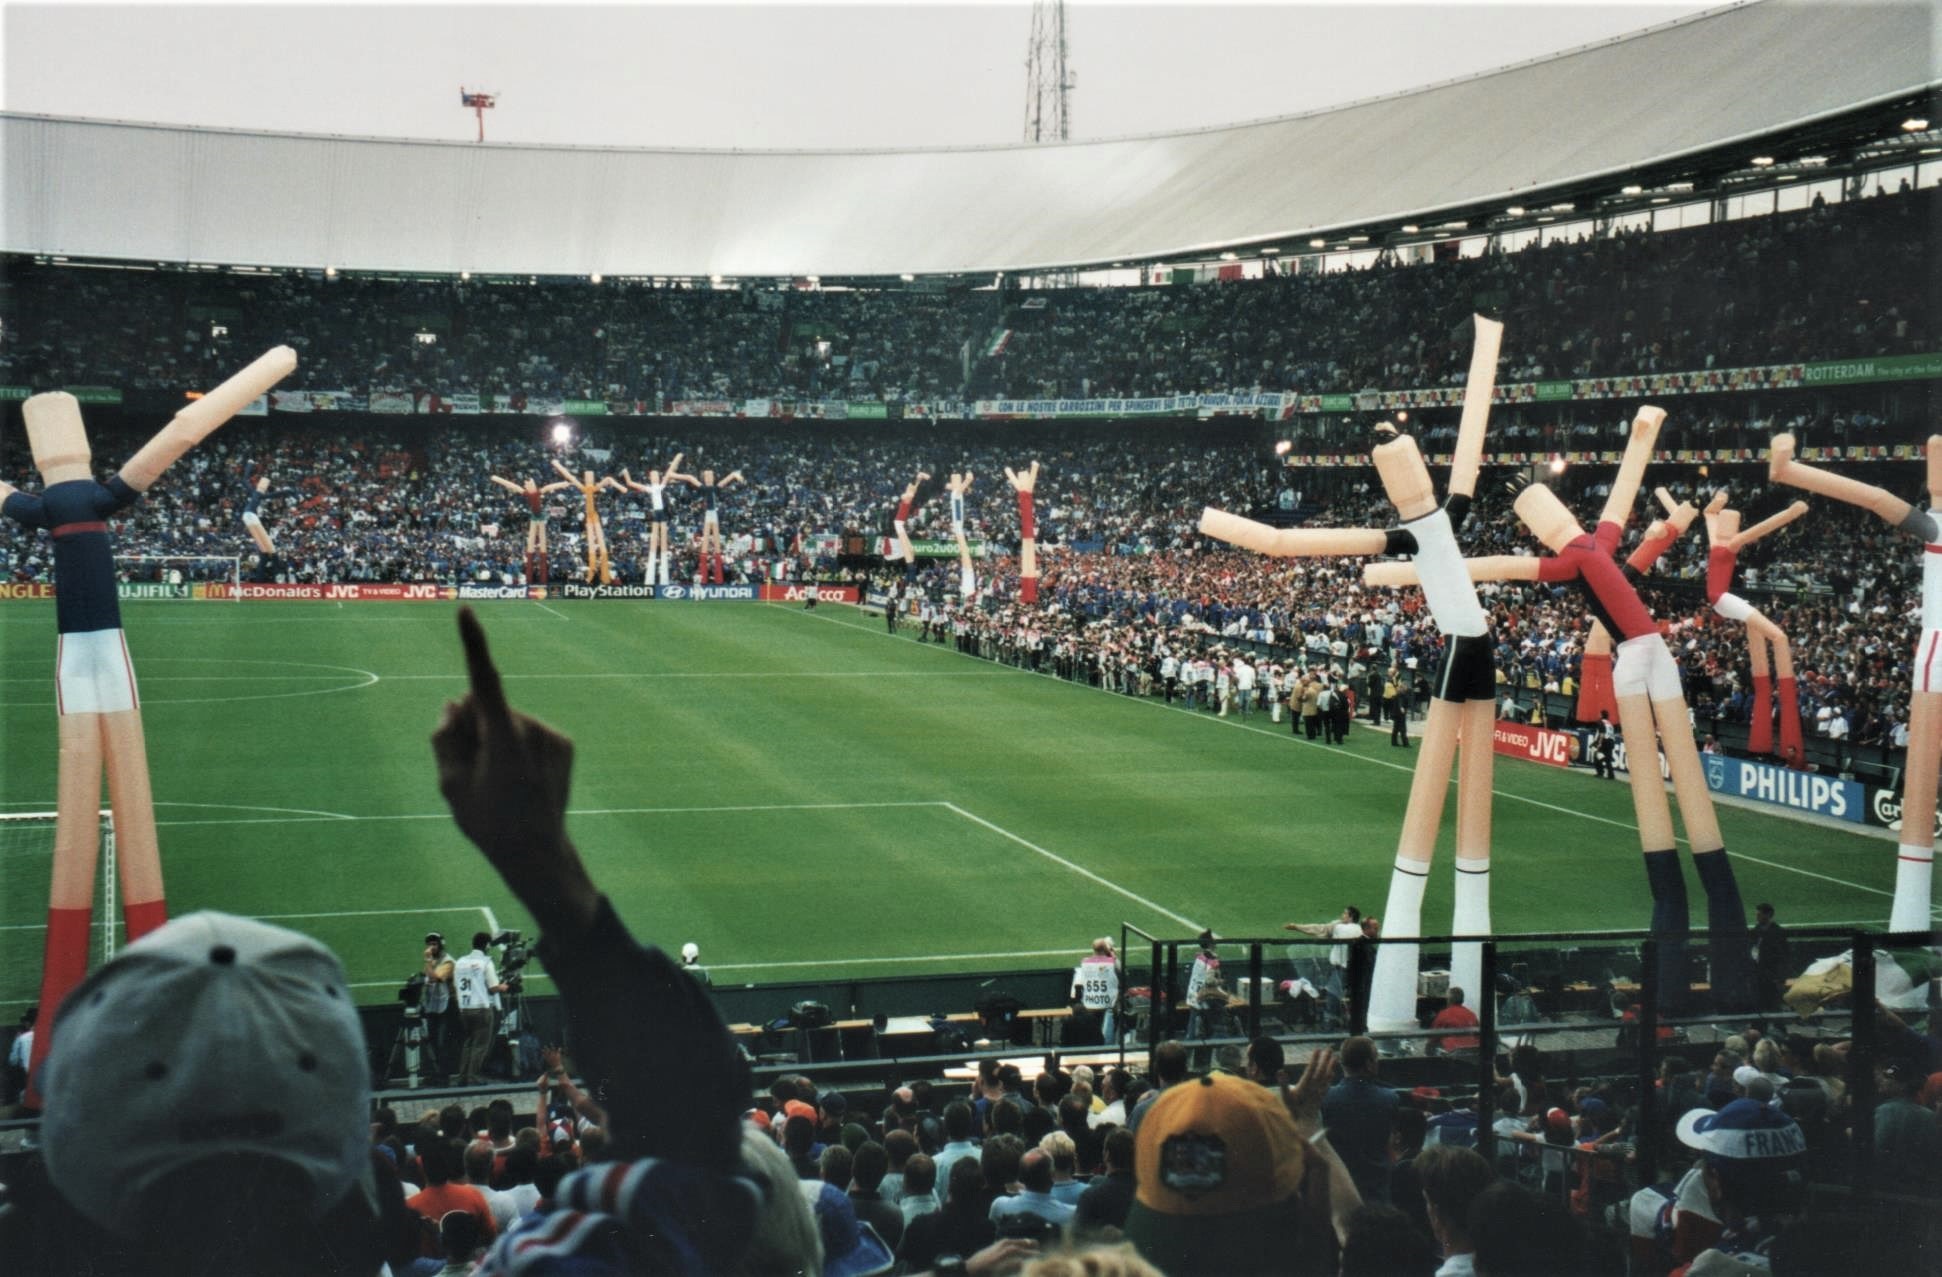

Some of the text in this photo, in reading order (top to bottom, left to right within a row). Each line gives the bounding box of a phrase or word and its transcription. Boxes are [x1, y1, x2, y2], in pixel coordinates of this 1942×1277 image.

[1806, 363, 1874, 380] ROTTERDAM
[911, 543, 978, 555] uro2000r
[118, 585, 189, 598] UJIFILM
[228, 586, 321, 598] McDonald's
[326, 585, 359, 598] JVC
[403, 585, 436, 598] JVC
[459, 586, 527, 599] MasterCard
[565, 584, 654, 600] PlayStation
[689, 587, 752, 598] HYUNDAI
[784, 586, 846, 601] Adcco
[1507, 732, 1529, 748] VIDEO
[1530, 731, 1567, 762] JVC
[1740, 763, 1847, 816] PHILIPS
[1086, 980, 1108, 993] 655
[1084, 994, 1111, 1005] PHOTO
[1746, 1127, 1804, 1156] FRAN
